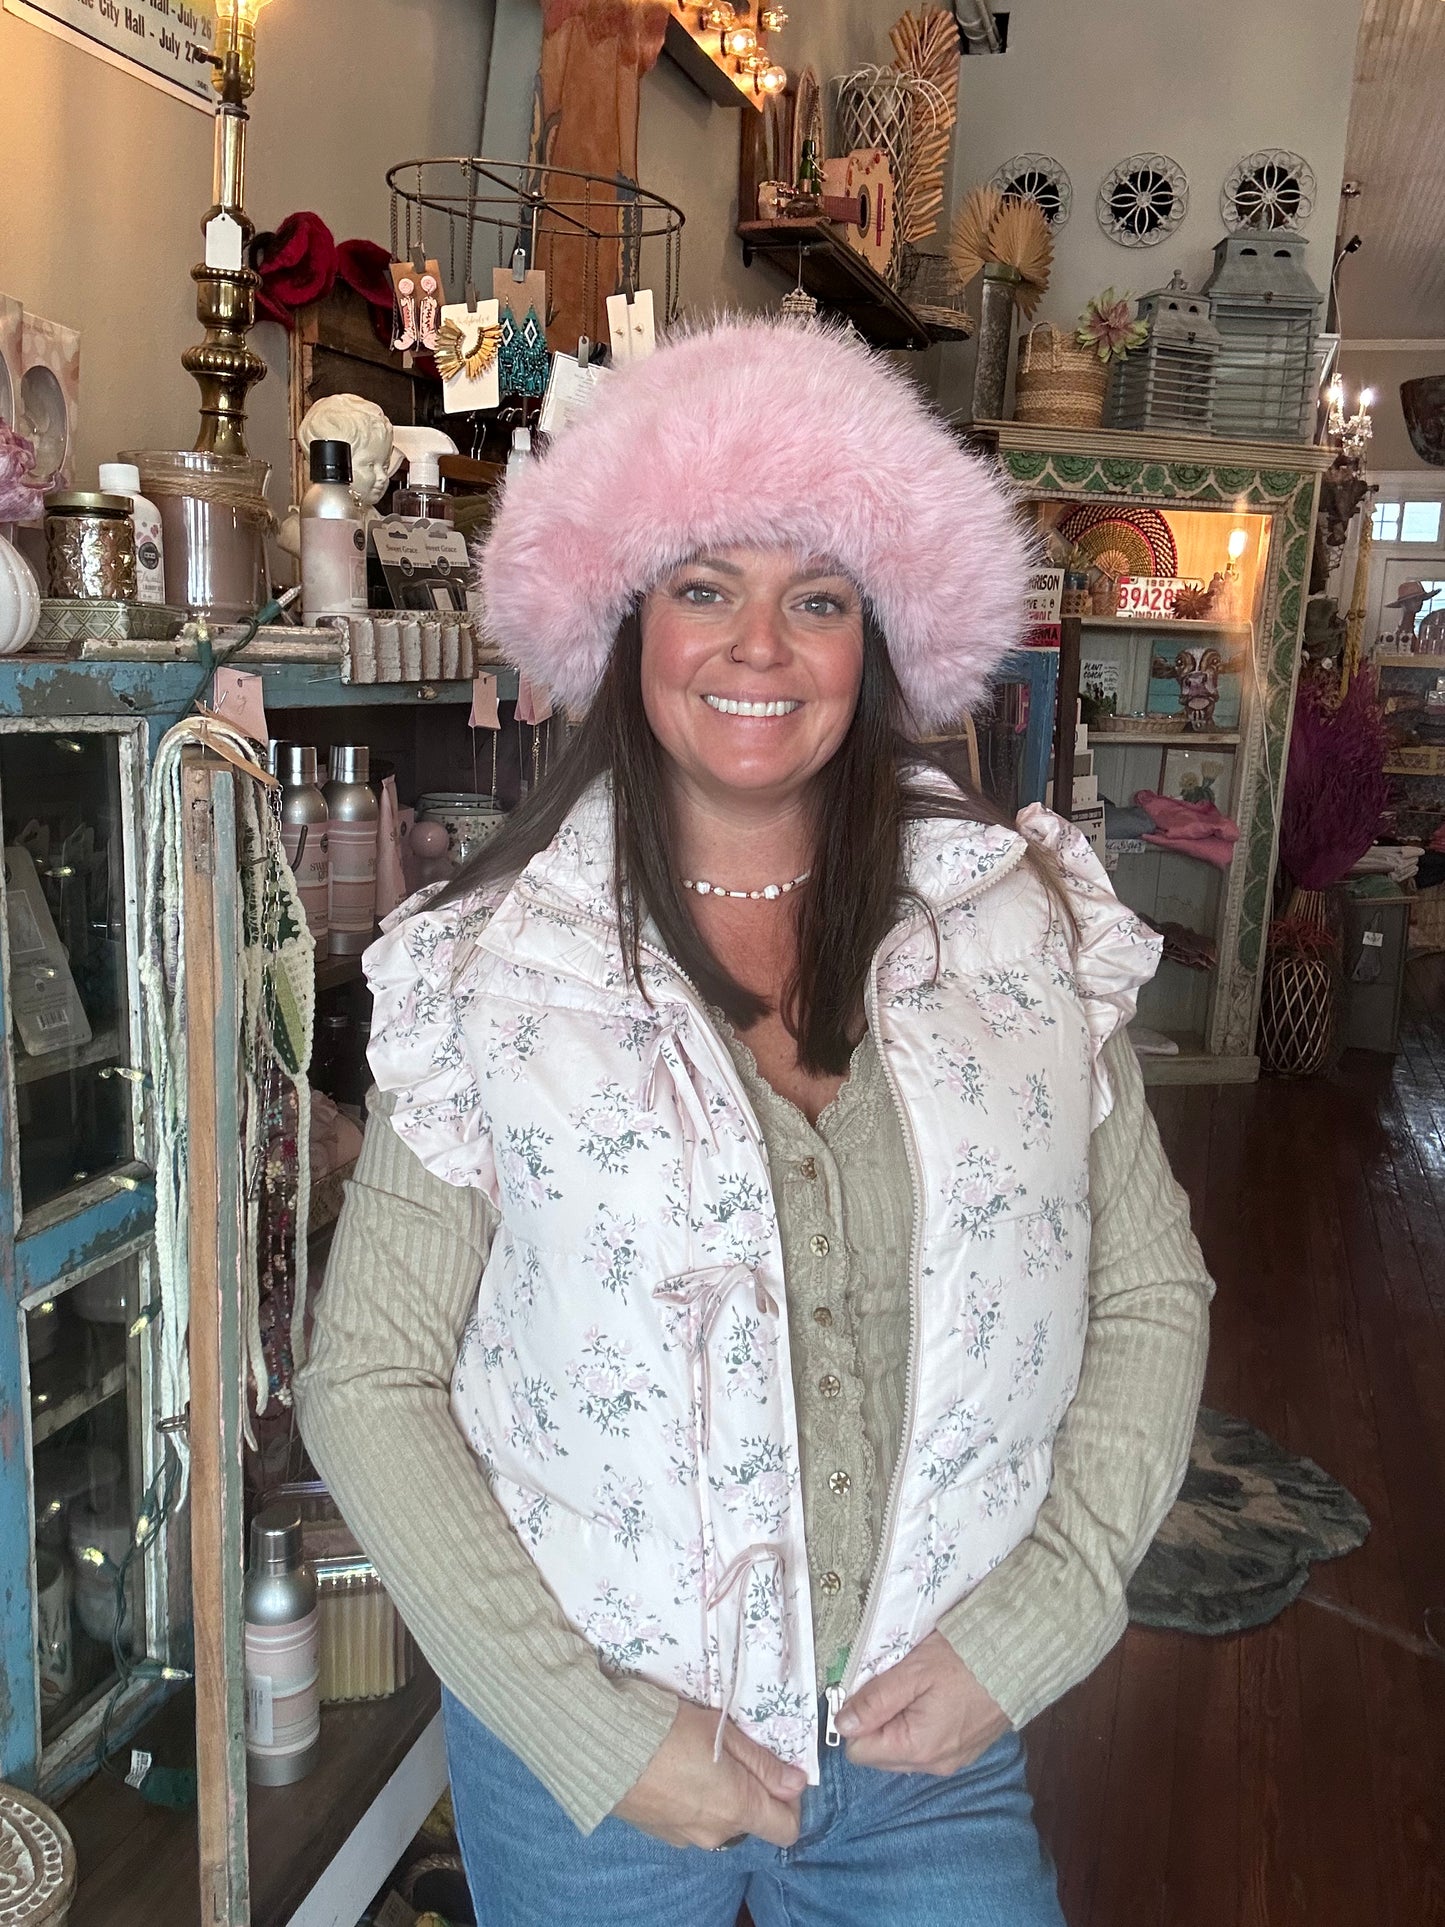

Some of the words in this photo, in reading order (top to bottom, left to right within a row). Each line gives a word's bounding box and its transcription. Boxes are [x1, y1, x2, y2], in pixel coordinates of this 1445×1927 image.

[177, 3, 198, 36] July
[201, 15, 212, 40] 26
[98, 0, 120, 27] City
[125, 6, 145, 38] Hall
[159, 27, 181, 60] July
[385, 543, 401, 553] Sweet
[401, 545, 418, 554] Grace
[440, 545, 457, 553] Grace
[1084, 662, 1103, 671] PLANT
[1083, 671, 1103, 680] COACH
